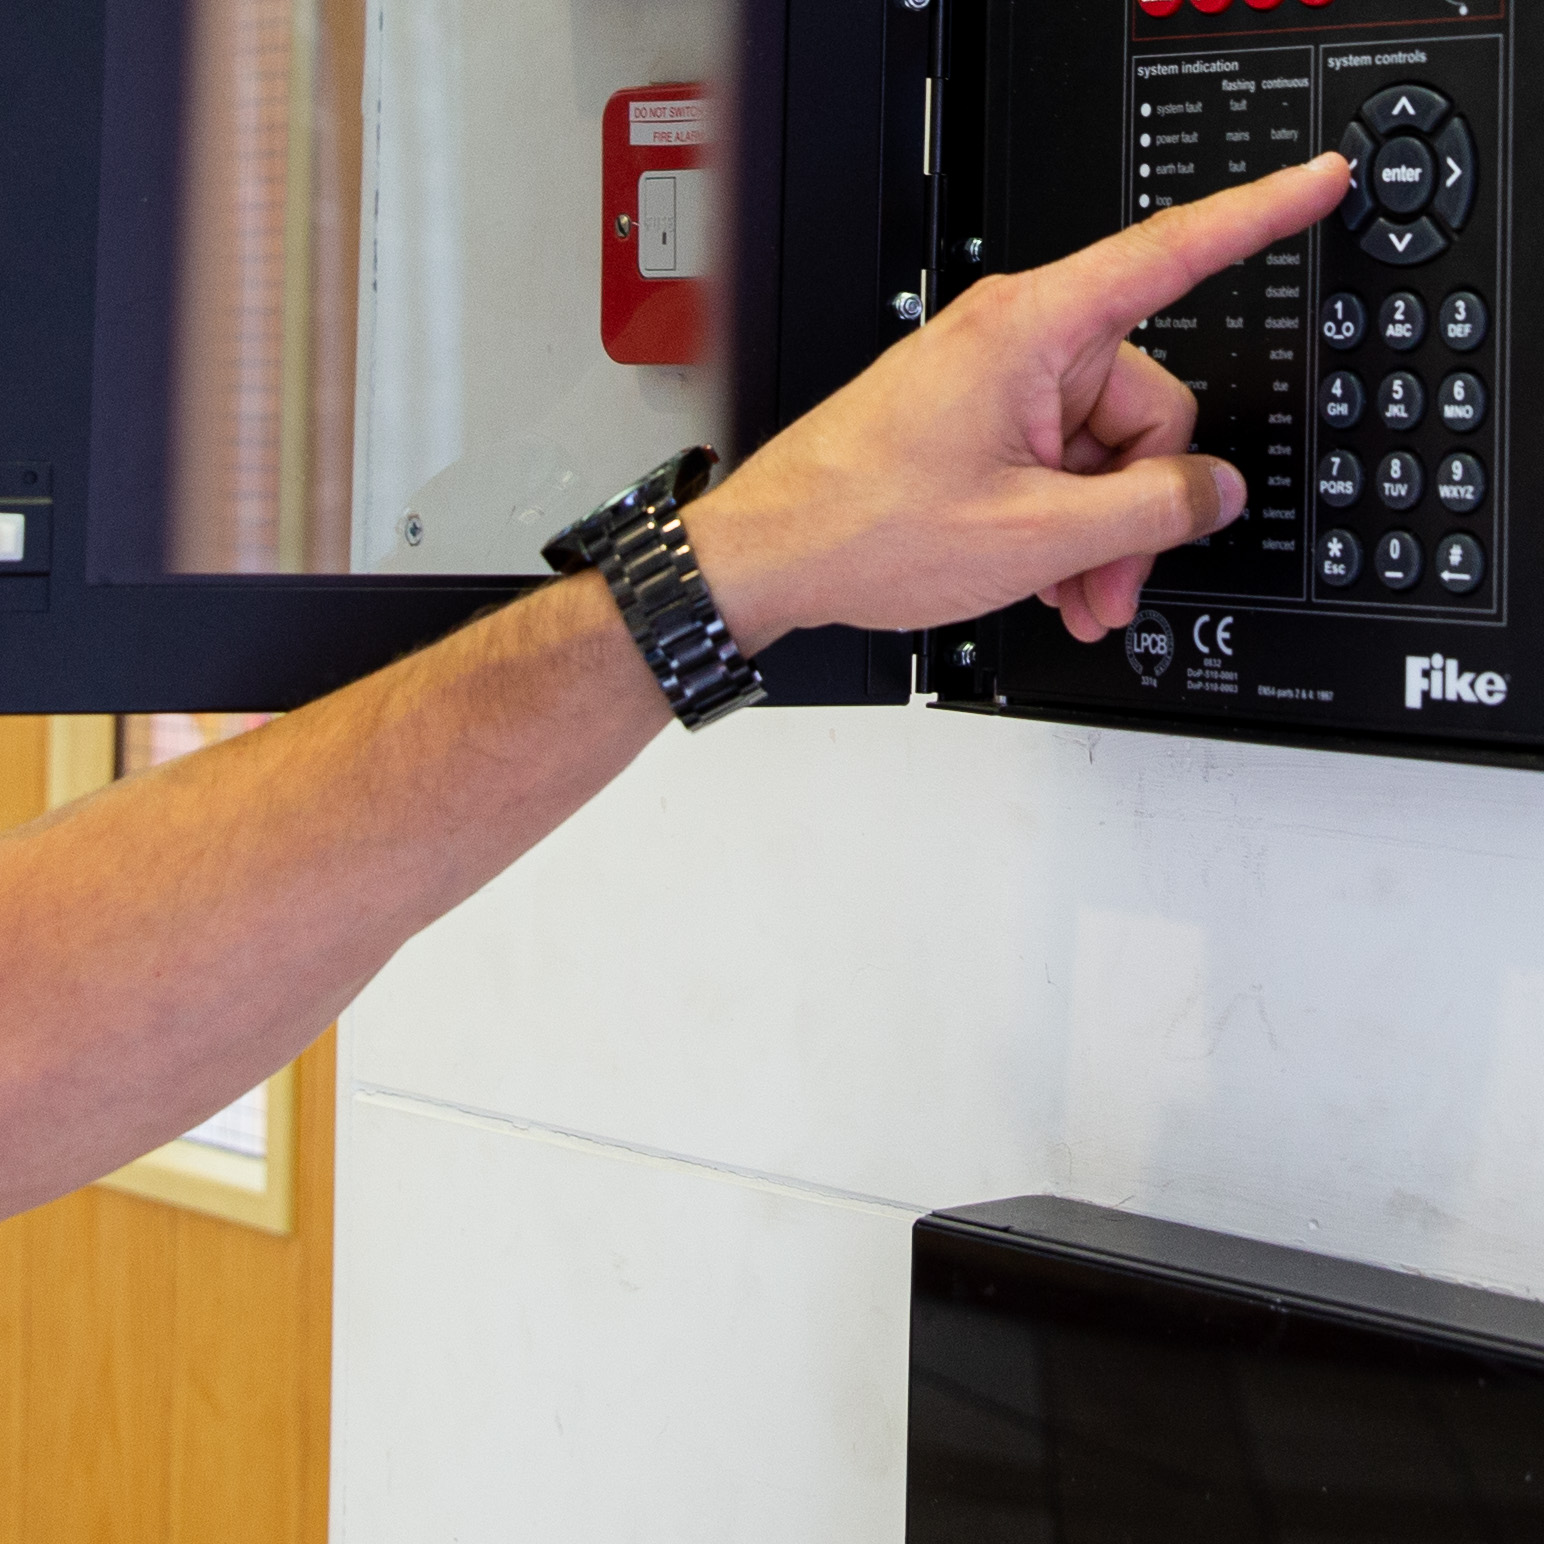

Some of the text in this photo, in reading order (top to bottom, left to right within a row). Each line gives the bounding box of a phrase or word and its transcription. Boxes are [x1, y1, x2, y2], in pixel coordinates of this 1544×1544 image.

[1327, 49, 1427, 70] system controls
[1137, 58, 1240, 79] system indication
[1221, 76, 1309, 93] flashing continuous
[634, 107, 647, 119] DO
[649, 106, 667, 119] NOT
[1156, 98, 1247, 117] system fault fault
[653, 131, 672, 143] FIRE
[1156, 127, 1299, 146] power fault mains battery
[1156, 160, 1247, 175] earth fault fault
[1381, 165, 1423, 184] enter
[1155, 194, 1173, 207] loop
[1265, 253, 1301, 266] disabled
[1265, 285, 1300, 298] disabled
[1334, 300, 1344, 320] 1
[1393, 300, 1405, 321] 2
[1454, 300, 1466, 321] 3
[1155, 315, 1299, 330] fault output fault disabled
[1385, 323, 1413, 338] ABC
[1447, 323, 1472, 338] DEF
[1269, 348, 1294, 360] active
[1272, 380, 1289, 392] due
[1331, 377, 1342, 399] 4
[1392, 379, 1404, 400] 5
[1453, 380, 1465, 401] 6
[1327, 402, 1349, 417] GHI
[1384, 404, 1408, 419] JKL
[1444, 405, 1473, 420] MNO
[1268, 413, 1293, 425] active
[1267, 444, 1292, 456] active
[1331, 456, 1341, 477] 7
[1390, 458, 1401, 480] 8
[1451, 460, 1463, 482] 9
[1267, 474, 1291, 486] active
[1319, 480, 1354, 496] PQRS
[1383, 482, 1408, 497] TUV
[1438, 484, 1475, 500] WXYZ
[1262, 507, 1296, 520] silenced
[1262, 538, 1295, 551] silenced
[1389, 539, 1401, 560] 0
[1324, 561, 1346, 576] Esc
[1193, 613, 1234, 656] CE
[1133, 632, 1168, 655] LPCB
[1405, 653, 1508, 710] Fike
